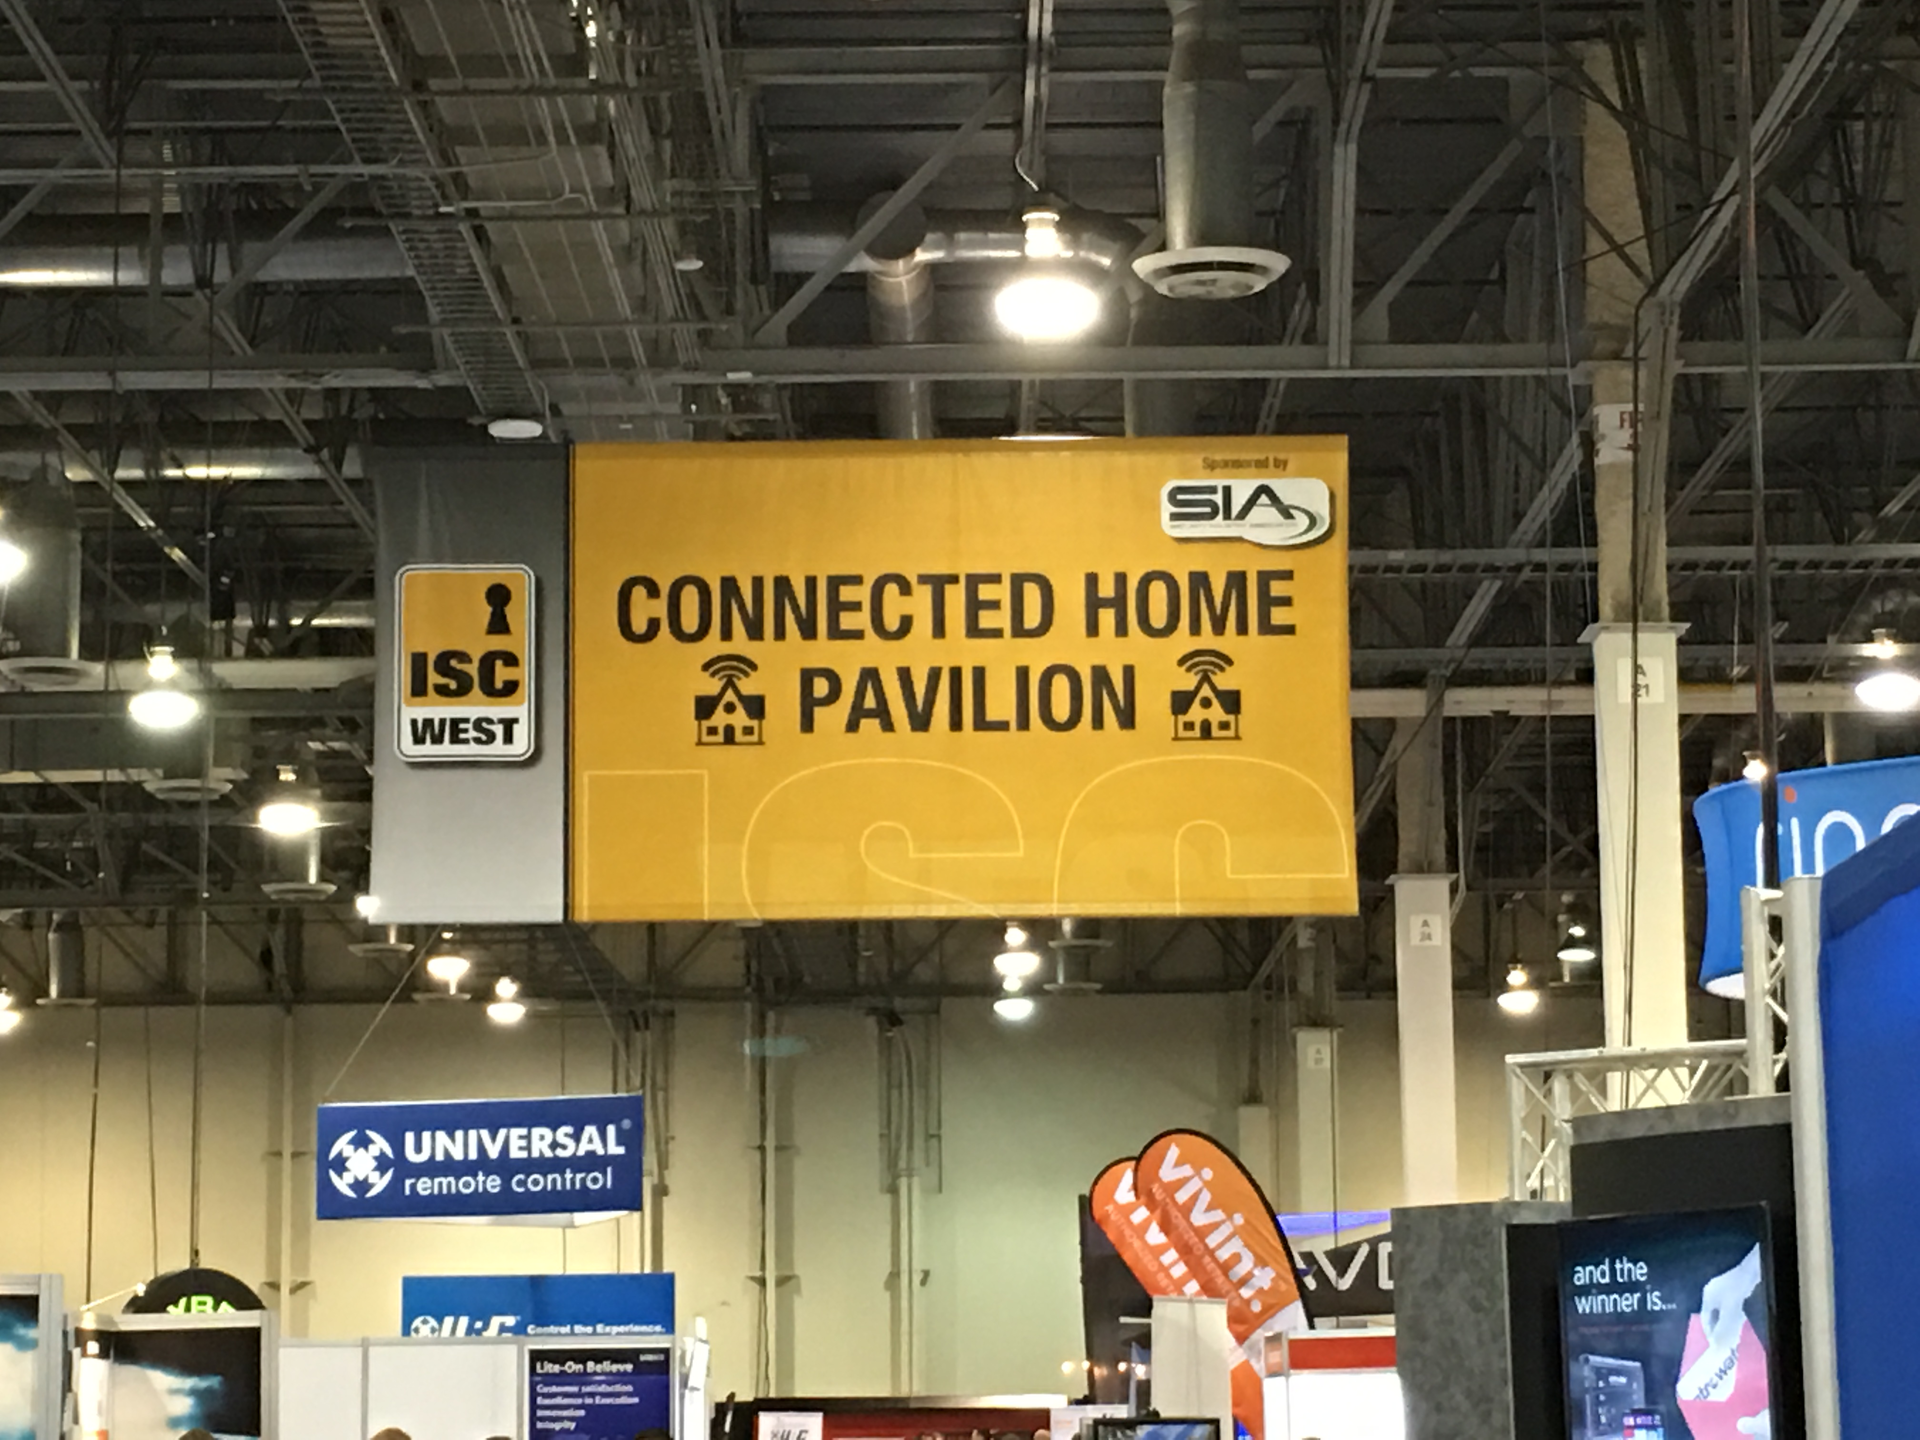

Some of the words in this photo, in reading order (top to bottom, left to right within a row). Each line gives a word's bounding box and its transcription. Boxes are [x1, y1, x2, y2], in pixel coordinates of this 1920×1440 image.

[1202, 457, 1269, 470] Sponsored
[1273, 456, 1289, 471] by
[1167, 484, 1297, 521] SIA
[617, 572, 1055, 643] CONNECTED
[1084, 569, 1296, 638] HOME
[410, 650, 520, 698] ISC
[799, 663, 1136, 734] PAVILION
[410, 716, 520, 746] WEST
[405, 1124, 626, 1163] UNIVERSAL
[404, 1171, 502, 1196] remote
[511, 1166, 613, 1193] control
[1159, 1142, 1276, 1313] vivint.
[1573, 1258, 1610, 1286] and
[1614, 1256, 1648, 1283] the
[1574, 1288, 1641, 1315] winner
[527, 1324, 571, 1335] Control
[573, 1324, 594, 1334] the
[596, 1323, 666, 1336] Experience.
[536, 1361, 584, 1374] Lite-On
[586, 1361, 634, 1374] Believe
